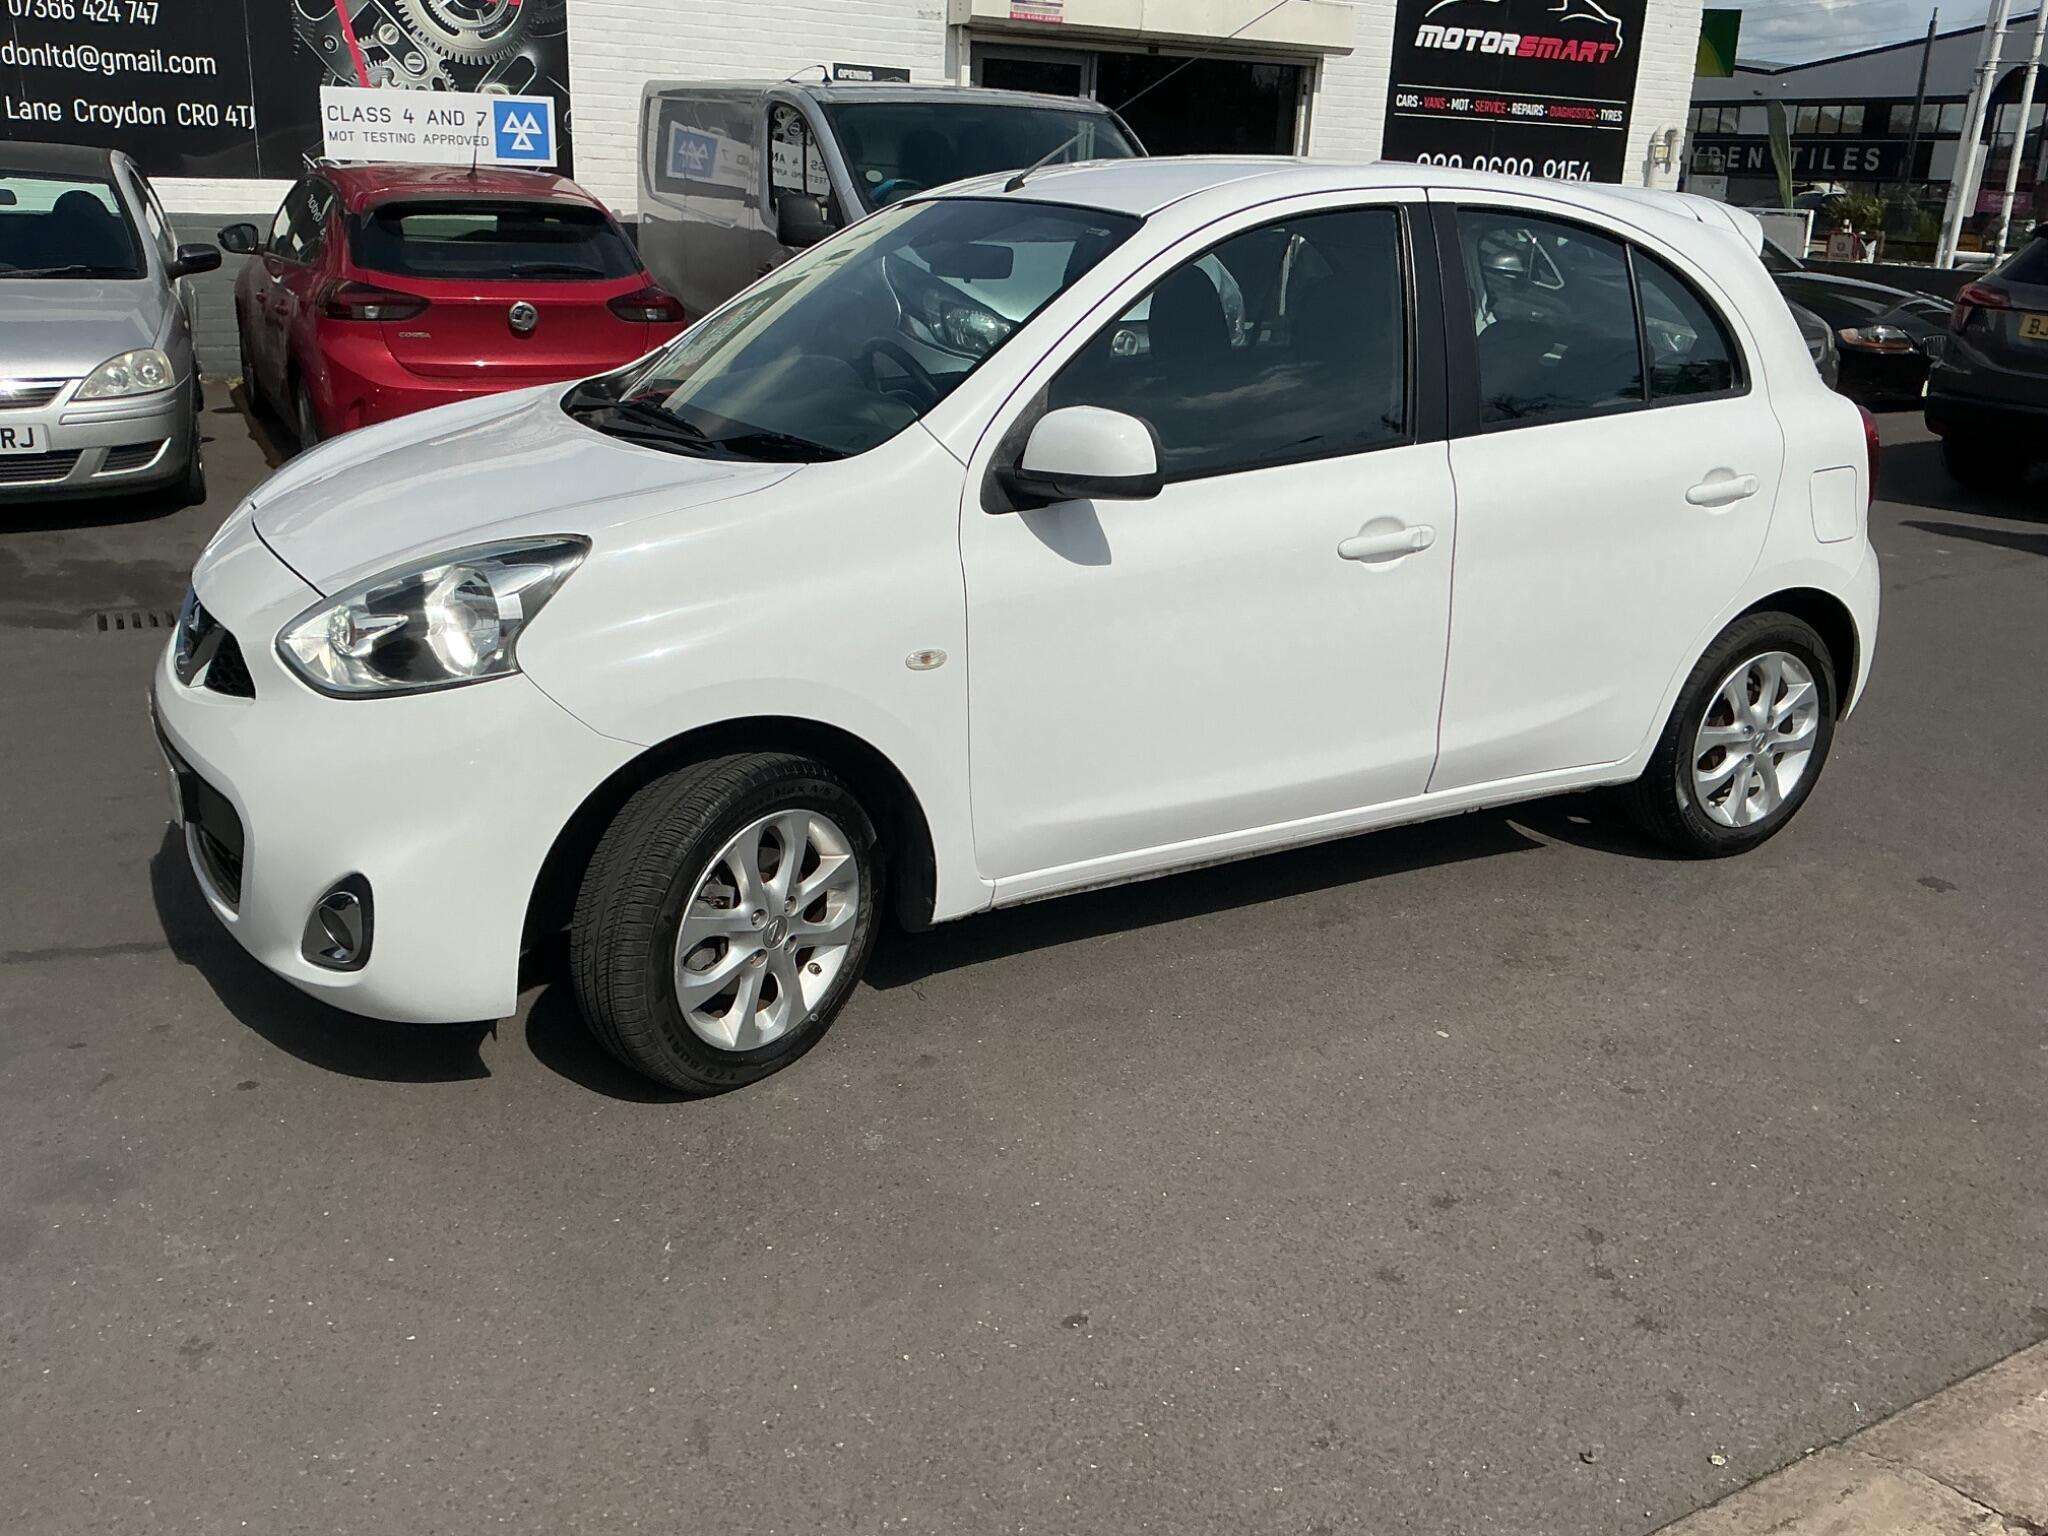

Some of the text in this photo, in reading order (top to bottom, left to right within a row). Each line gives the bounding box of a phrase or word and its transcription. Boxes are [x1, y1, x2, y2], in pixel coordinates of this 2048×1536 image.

[82, 0, 121, 23] 424
[124, 1, 159, 25] 747
[1414, 24, 1617, 64] MOTORSMART
[1, 40, 217, 76] donltd@gmail.com
[4, 95, 61, 121] Lane
[74, 98, 167, 128] Croydon
[225, 105, 256, 129] 4TJ
[327, 105, 487, 128] CLASS 4 AND 7
[1396, 94, 1418, 108] CARS
[1424, 97, 1445, 110] VANS
[1451, 98, 1469, 111] MOT
[1475, 100, 1507, 114] SERVICE
[1511, 102, 1545, 117] REPAIRS
[1600, 109, 1623, 122] TYRES
[328, 130, 490, 147] MOT TESTING APPROVED
[0, 427, 34, 449] RJ
